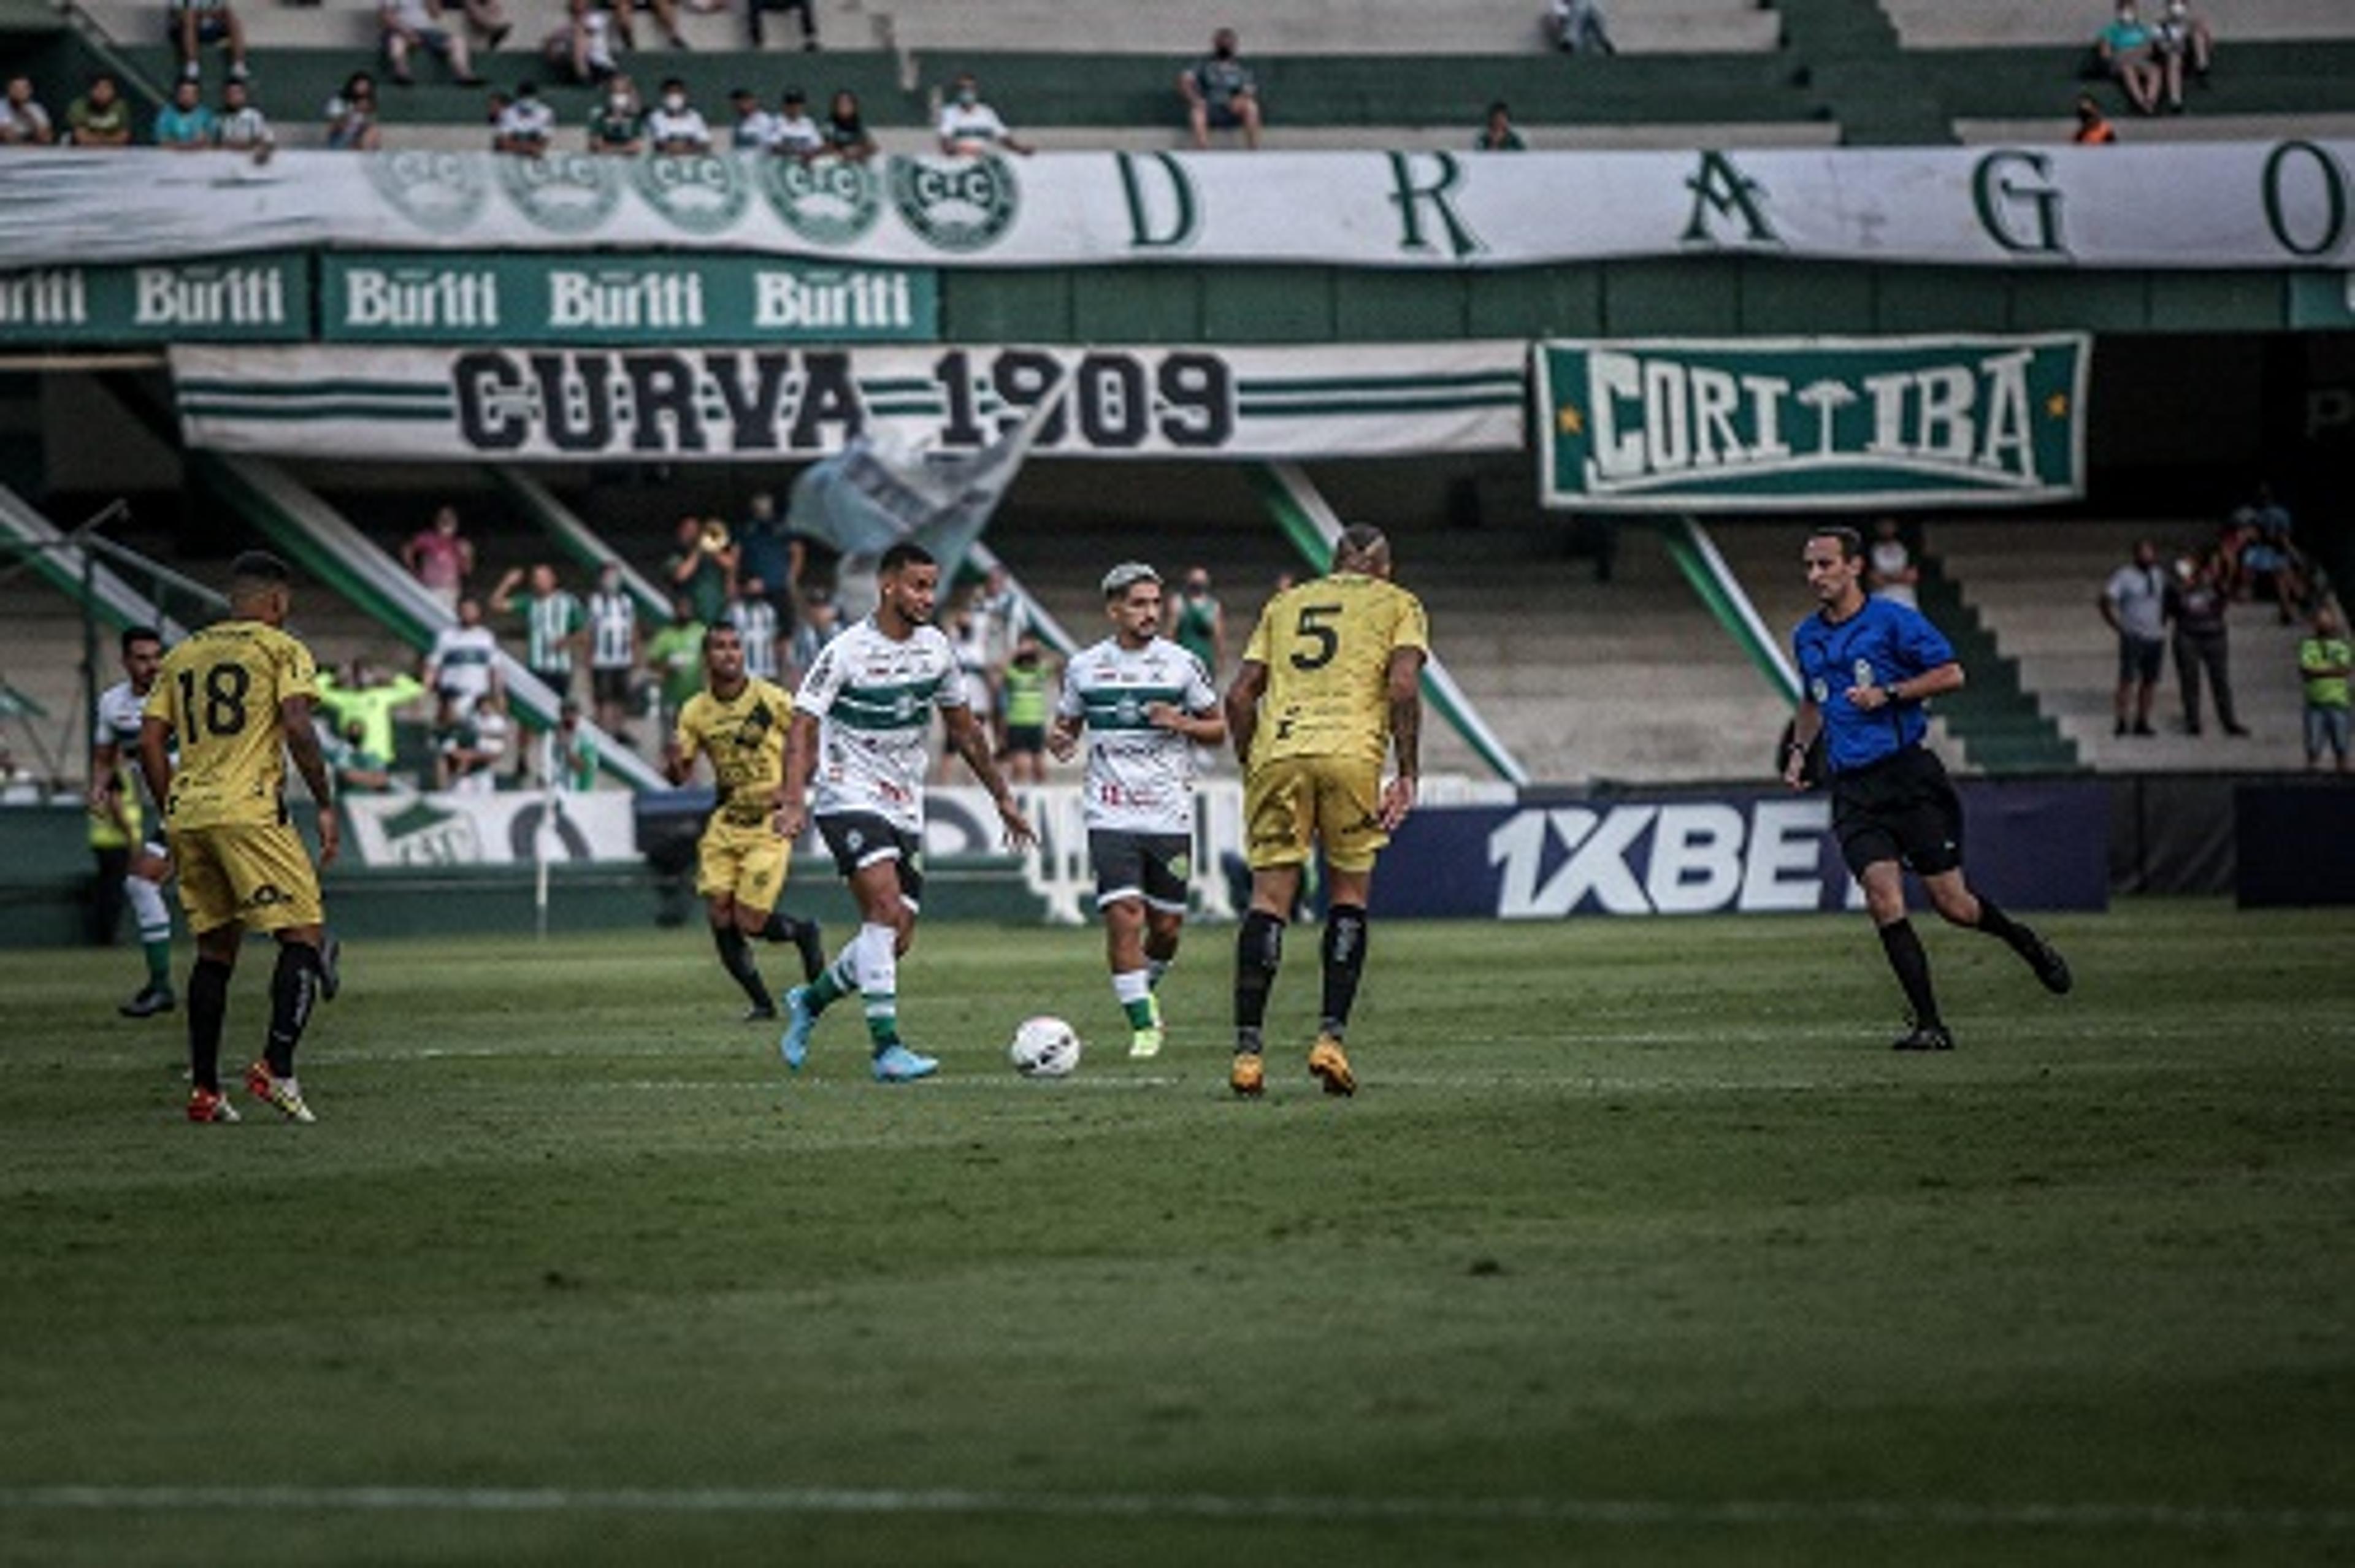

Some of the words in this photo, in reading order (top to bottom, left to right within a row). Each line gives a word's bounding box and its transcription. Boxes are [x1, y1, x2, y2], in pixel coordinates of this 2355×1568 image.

[454, 351, 862, 453] CURVA
[933, 349, 1233, 448] 1909
[1290, 602, 1342, 670] 5
[178, 662, 250, 744] 18
[1488, 799, 1866, 919] 1XBE
